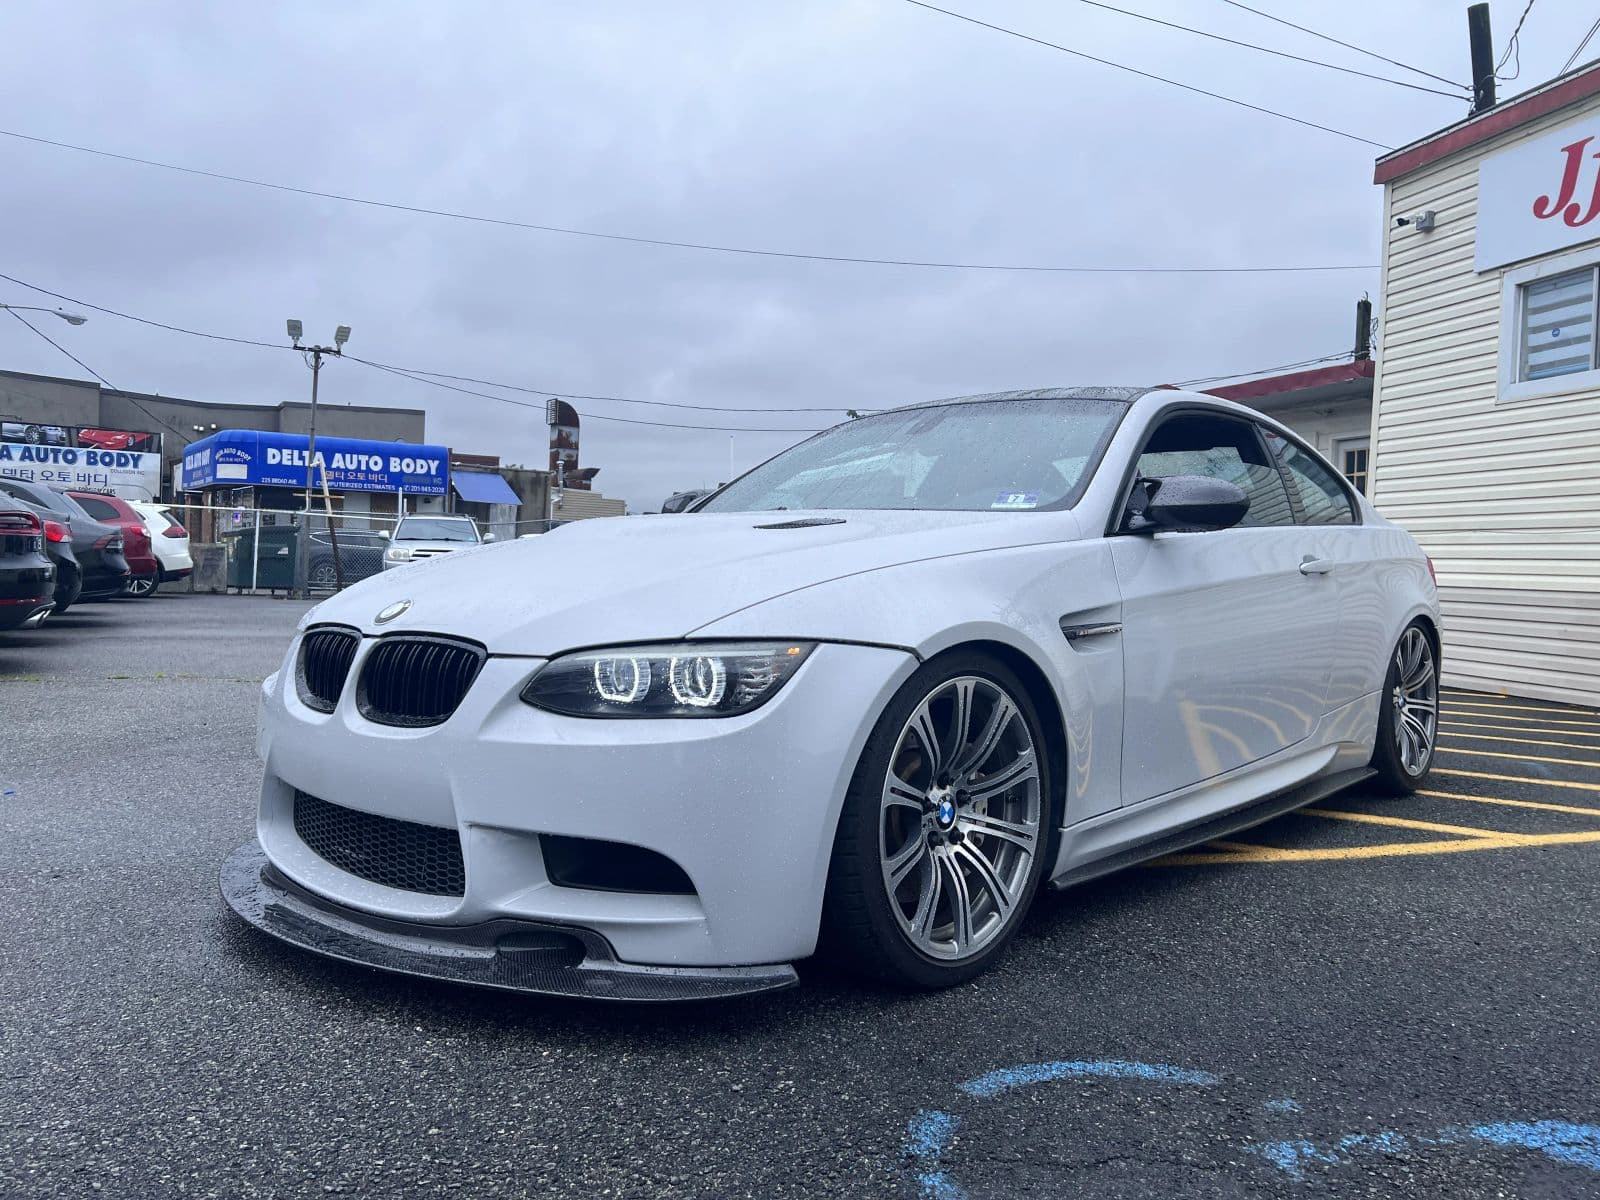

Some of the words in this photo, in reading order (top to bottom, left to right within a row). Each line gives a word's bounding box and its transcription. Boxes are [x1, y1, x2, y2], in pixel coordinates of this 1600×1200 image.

[19, 446, 78, 465] AUTO
[86, 450, 144, 469] BODY
[267, 447, 326, 468] DELTA
[331, 453, 383, 472] AUTO
[389, 456, 440, 475] BODY
[40, 470, 71, 482] 오토
[77, 472, 108, 486] 바디
[316, 480, 363, 489] CMPUTERIZED
[363, 483, 396, 491] ESTIMATES
[347, 472, 366, 480] 오토
[368, 473, 388, 483] 바디
